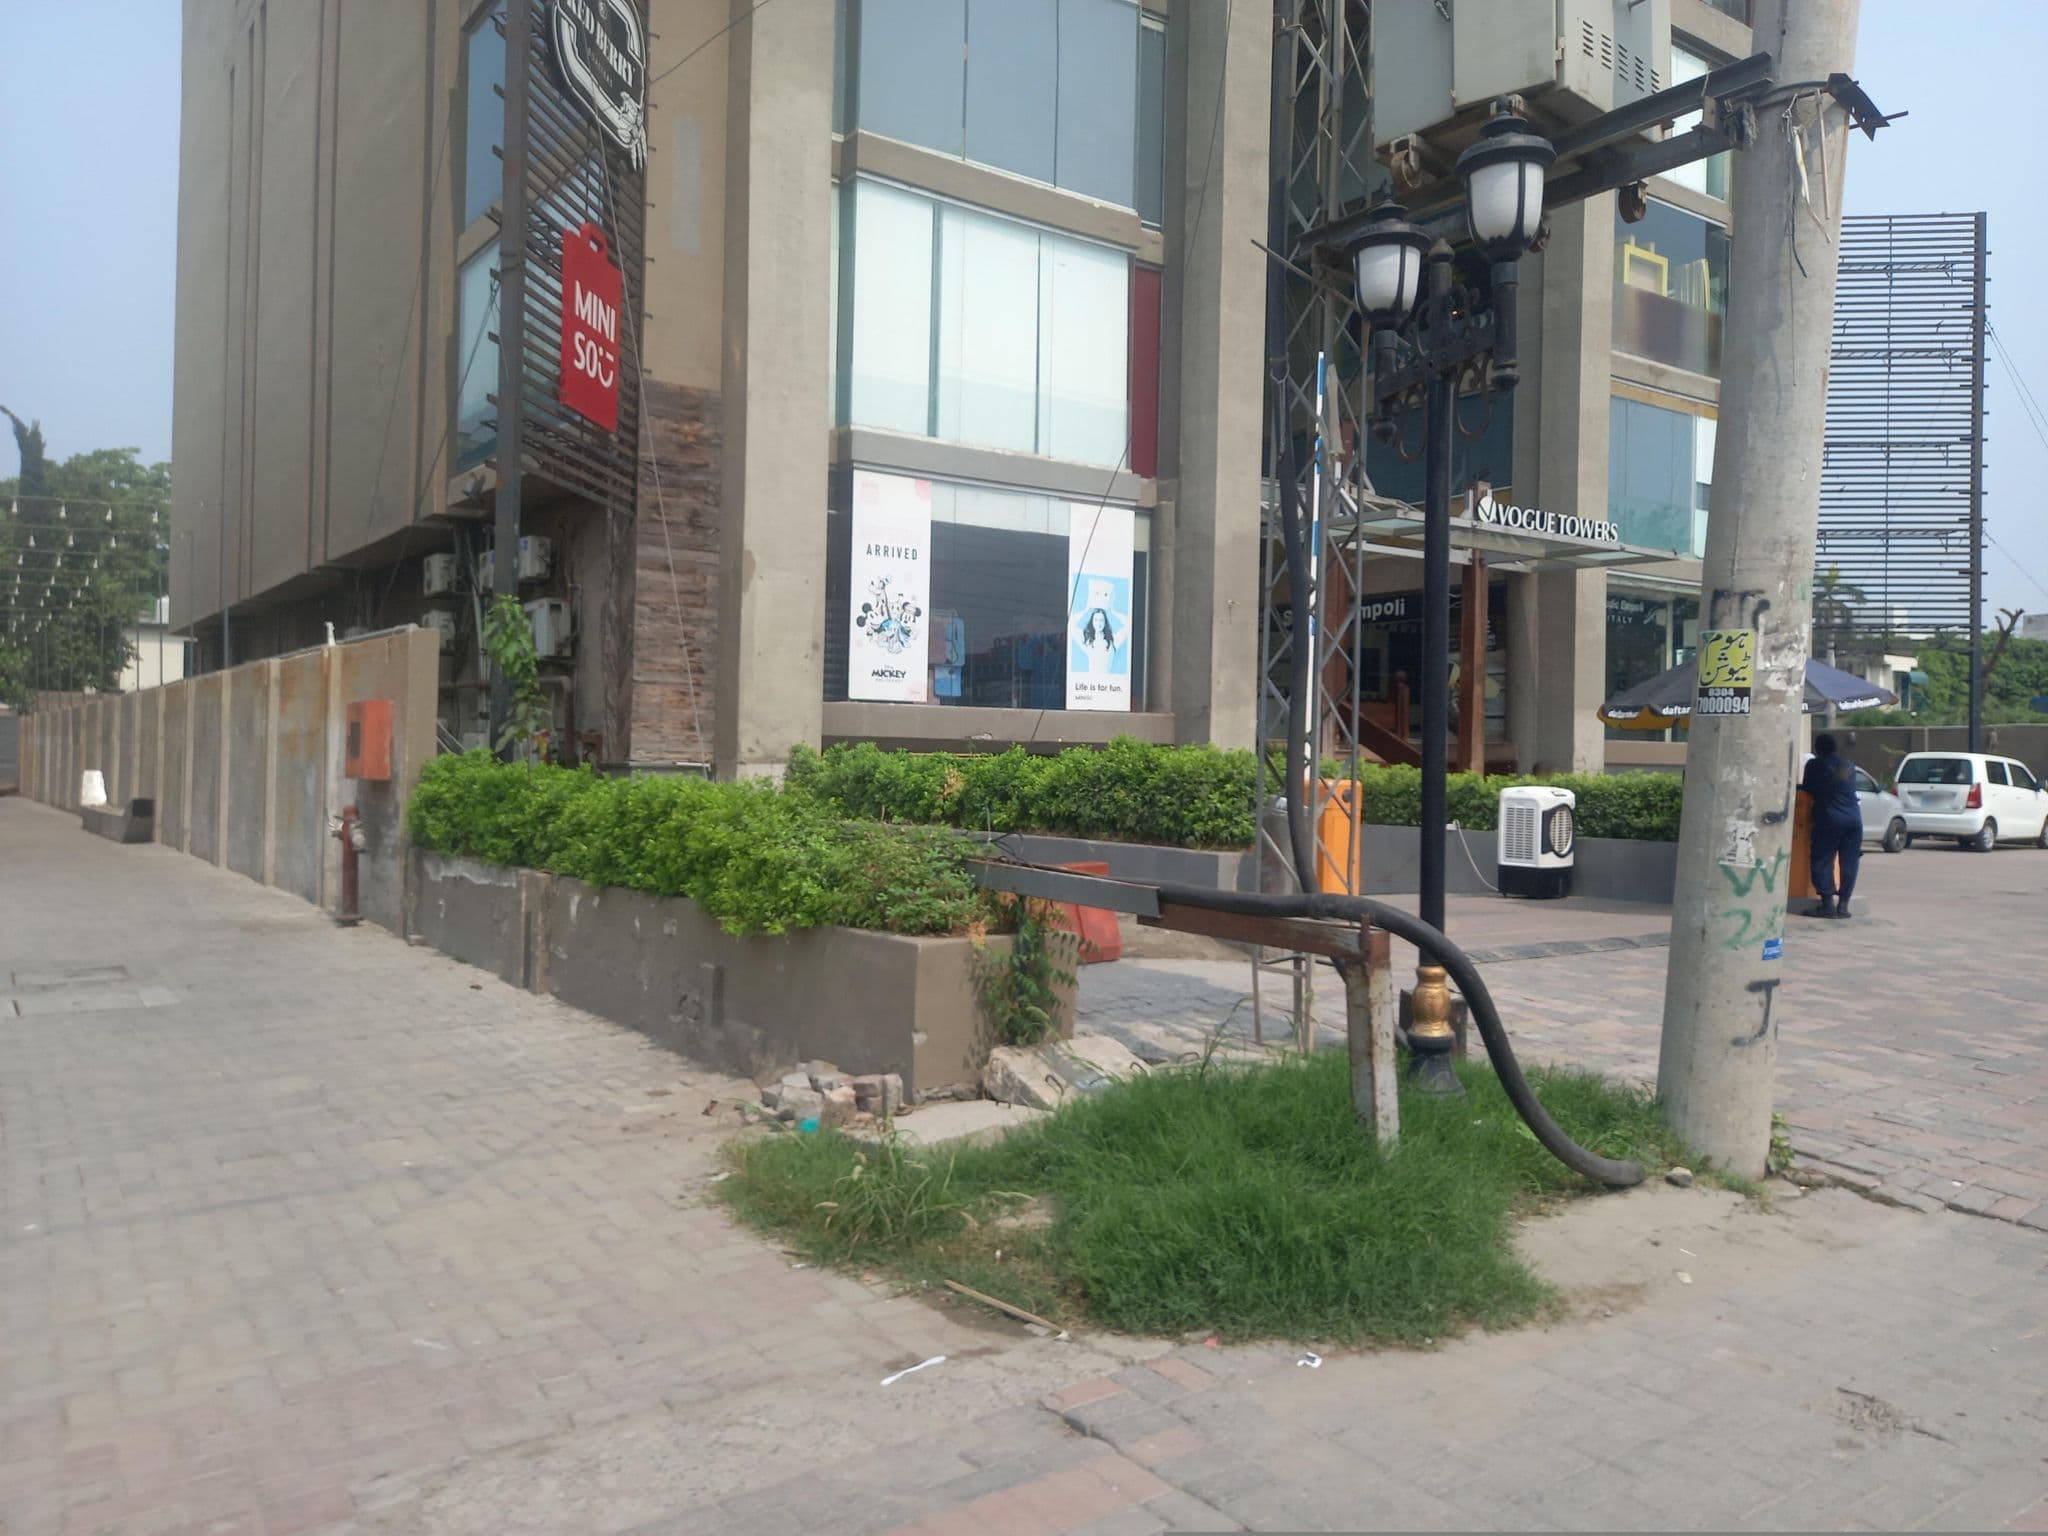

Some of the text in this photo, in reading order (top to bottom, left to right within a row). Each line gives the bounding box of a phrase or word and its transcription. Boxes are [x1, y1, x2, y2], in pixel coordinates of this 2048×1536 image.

[597, 21, 632, 87] BERRY
[575, 280, 616, 342] MINI
[1498, 504, 1618, 542] VOGUE TOWERS
[866, 544, 918, 560] ARRIVED
[871, 668, 907, 679] MICKEY
[1074, 683, 1088, 691] Life
[1097, 684, 1107, 692] for
[1698, 696, 1750, 713] 7000094
